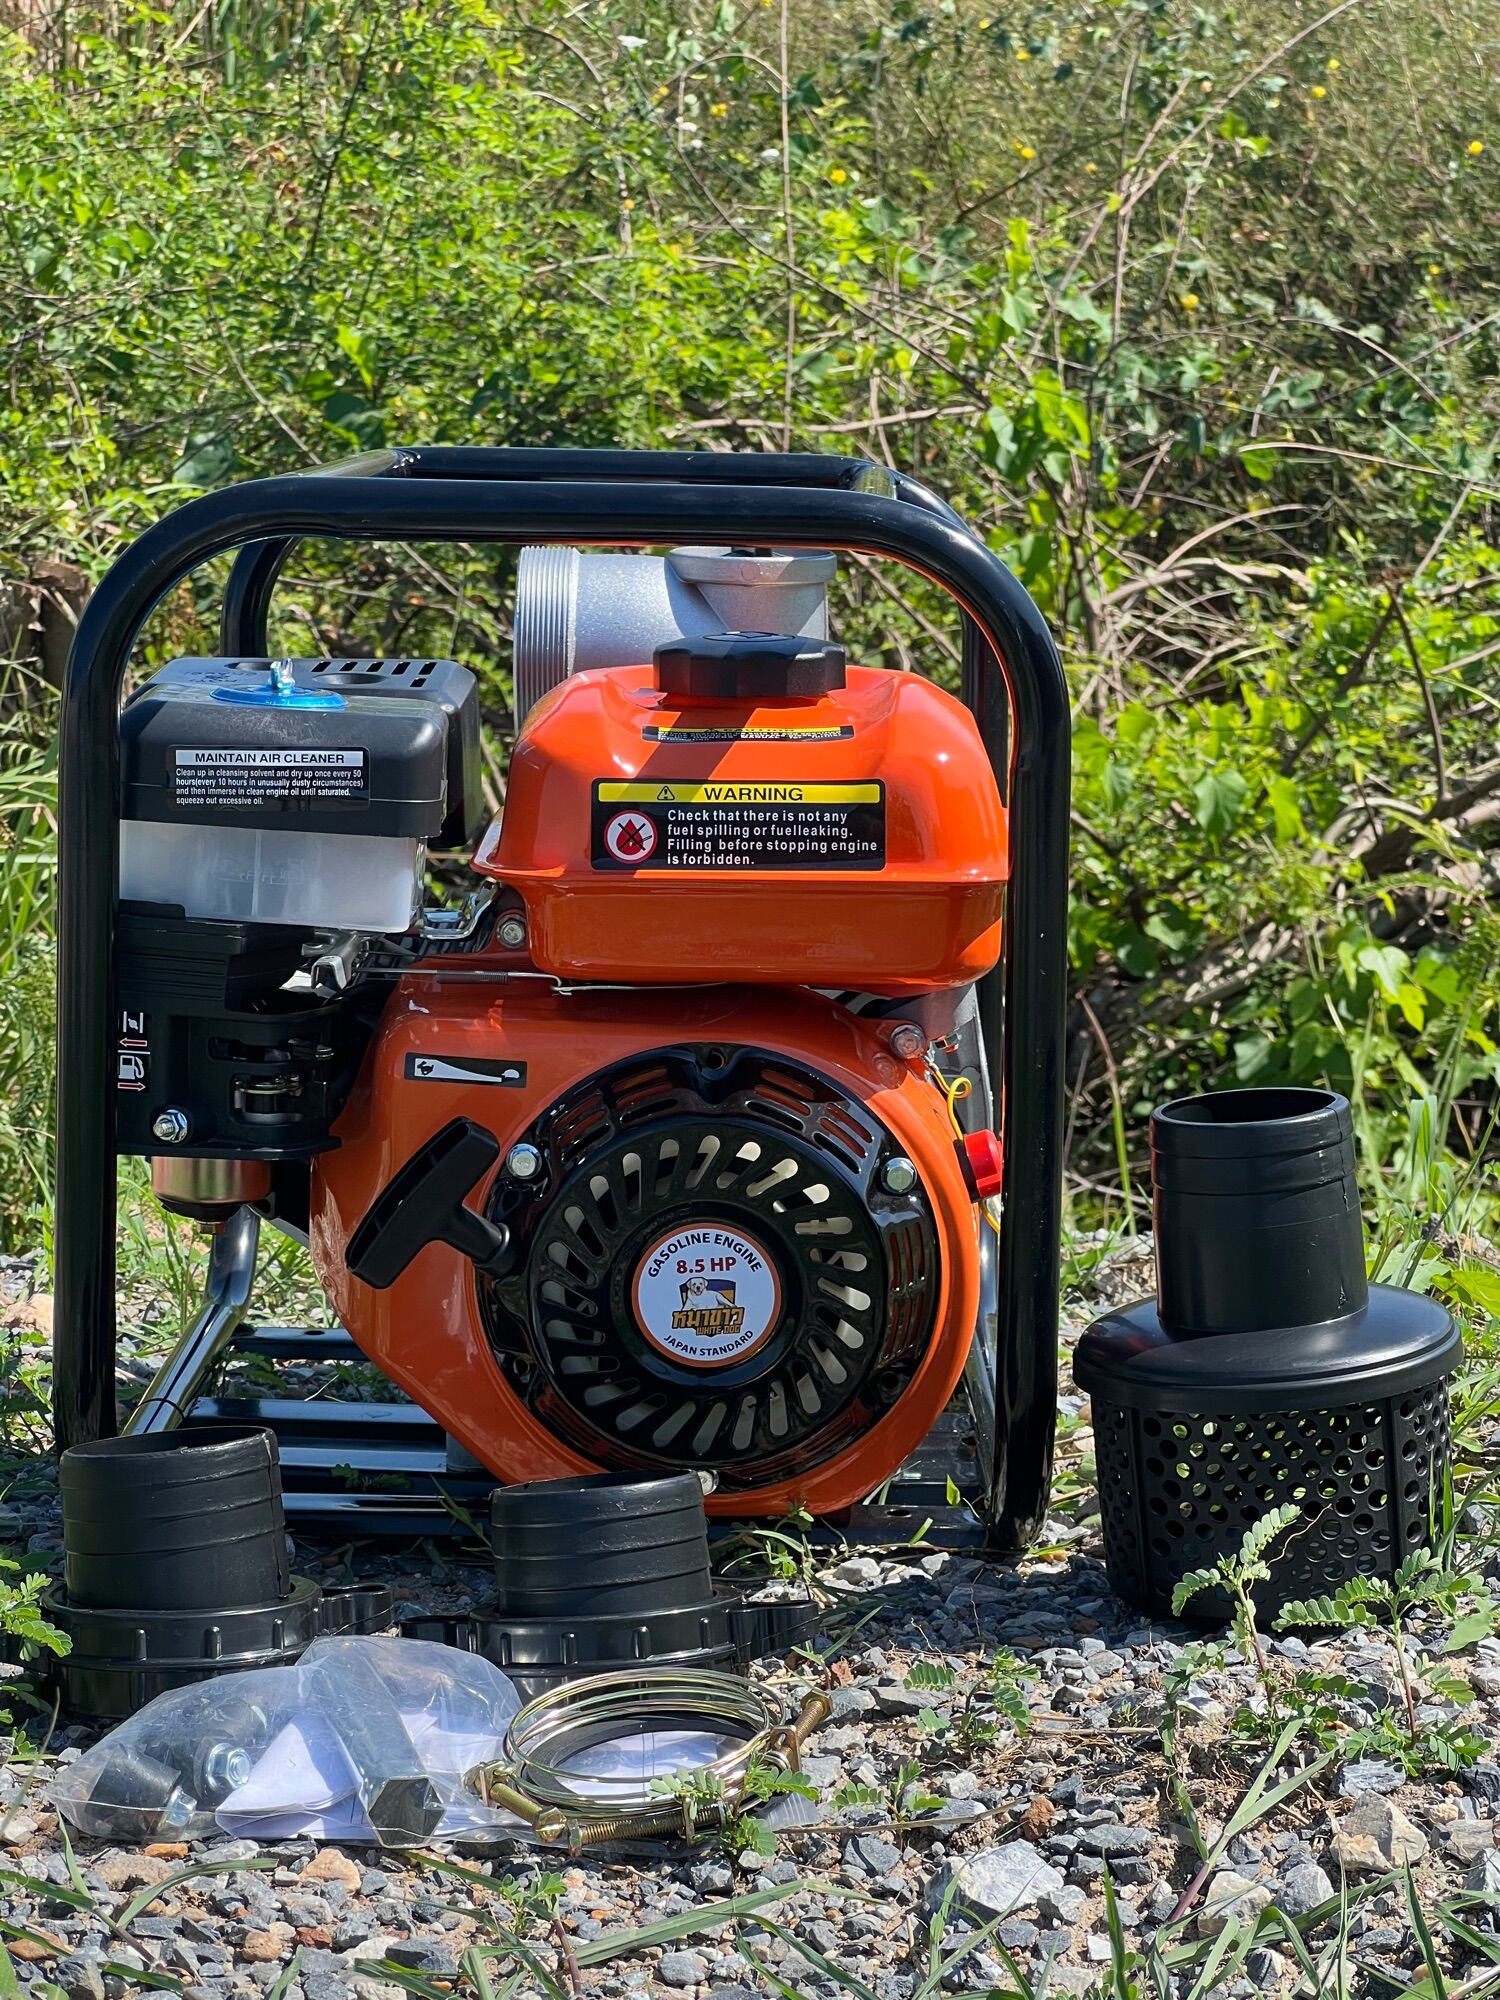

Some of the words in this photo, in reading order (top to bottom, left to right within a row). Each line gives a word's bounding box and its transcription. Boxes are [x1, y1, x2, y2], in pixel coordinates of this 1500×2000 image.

[195, 753, 256, 763] MAINTAIN
[260, 753, 280, 763] AIR
[284, 754, 344, 764] CLEANER
[176, 768, 196, 776] Clean
[197, 770, 206, 778] up
[216, 769, 248, 778] cleansing
[250, 769, 275, 777] solvent
[291, 770, 302, 779] dry
[333, 771, 351, 779] every
[176, 778, 216, 787] hours(every
[218, 778, 227, 786] 10
[228, 778, 247, 786] hours
[258, 779, 290, 788] unusually
[292, 779, 311, 788] dusty
[312, 779, 364, 788] circumstances)
[246, 788, 265, 796] clean
[266, 788, 289, 797] engine
[290, 788, 299, 796] oil
[301, 788, 316, 796] until
[318, 788, 351, 796] saturated.
[704, 788, 803, 801] WARNING
[219, 797, 252, 805] excessive
[253, 797, 264, 805] oil.
[668, 810, 710, 821] Check
[713, 810, 740, 821] that
[743, 810, 779, 821] there
[783, 810, 795, 821] is
[798, 811, 820, 821] not
[823, 813, 847, 825] any
[668, 824, 694, 836] fuel
[697, 824, 750, 838] spilling
[753, 827, 768, 836] or
[771, 825, 853, 839] fuelleaking.
[668, 839, 712, 853] Filling
[719, 839, 763, 851] before
[766, 840, 828, 854] stopping
[831, 840, 878, 854] engine
[668, 854, 679, 865] is
[683, 854, 755, 865] forbidden.
[648, 1233, 711, 1278] GASOLINE
[714, 1233, 763, 1273] ENGINE
[676, 1259, 705, 1274] 8.5
[710, 1257, 737, 1272] HP
[673, 1308, 744, 1328] หมาขาว
[696, 1326, 722, 1335] WHITE
[724, 1325, 740, 1334] DOG
[664, 1335, 698, 1356] JAPAN
[699, 1330, 754, 1357] STANDARD
